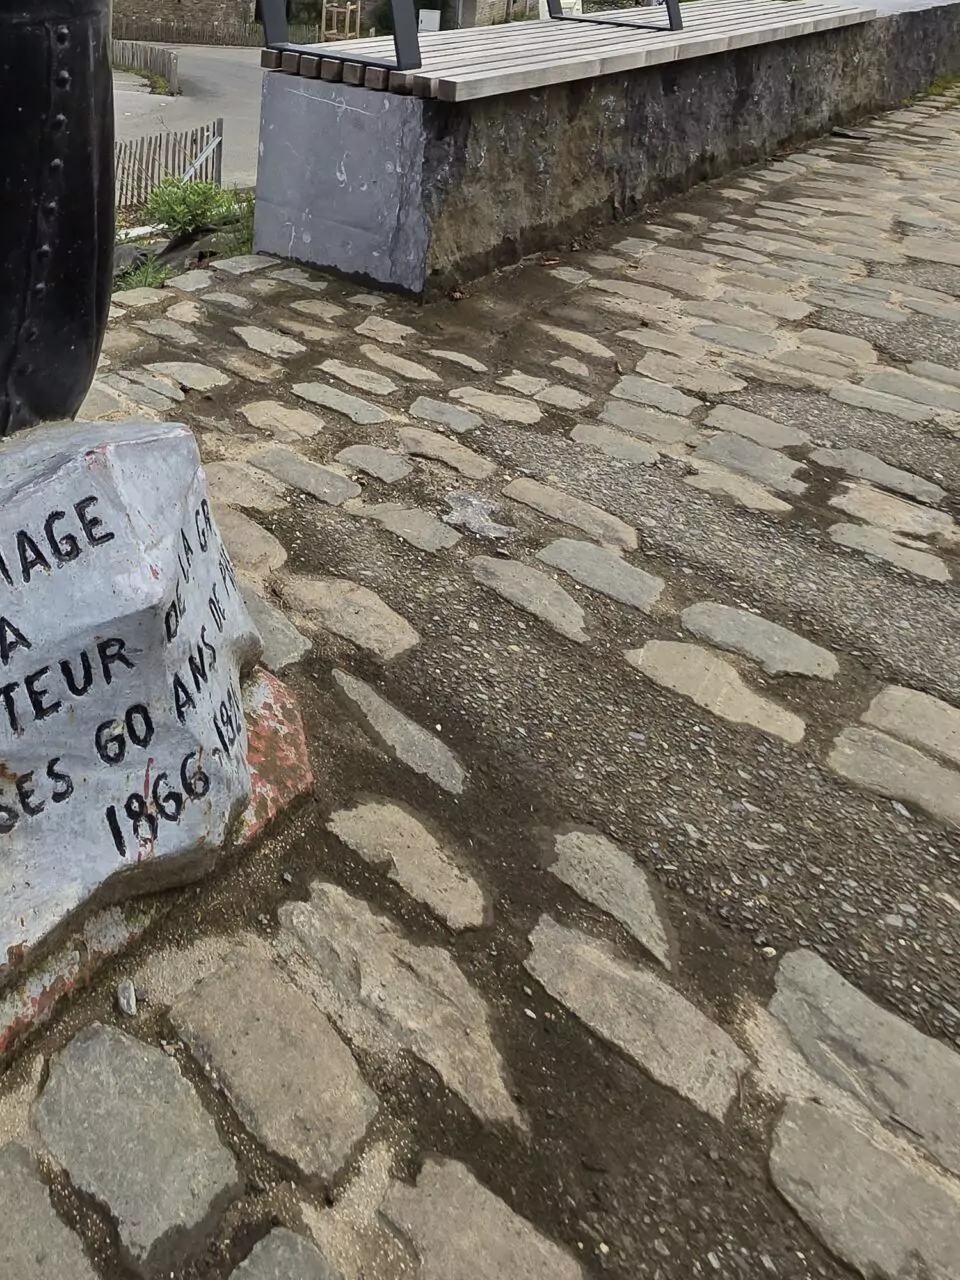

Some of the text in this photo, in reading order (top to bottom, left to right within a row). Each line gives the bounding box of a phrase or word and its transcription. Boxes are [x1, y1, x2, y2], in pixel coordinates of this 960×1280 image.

[178, 528, 194, 584] LA
[173, 625, 217, 726] ANS
[105, 751, 212, 858] 1866
